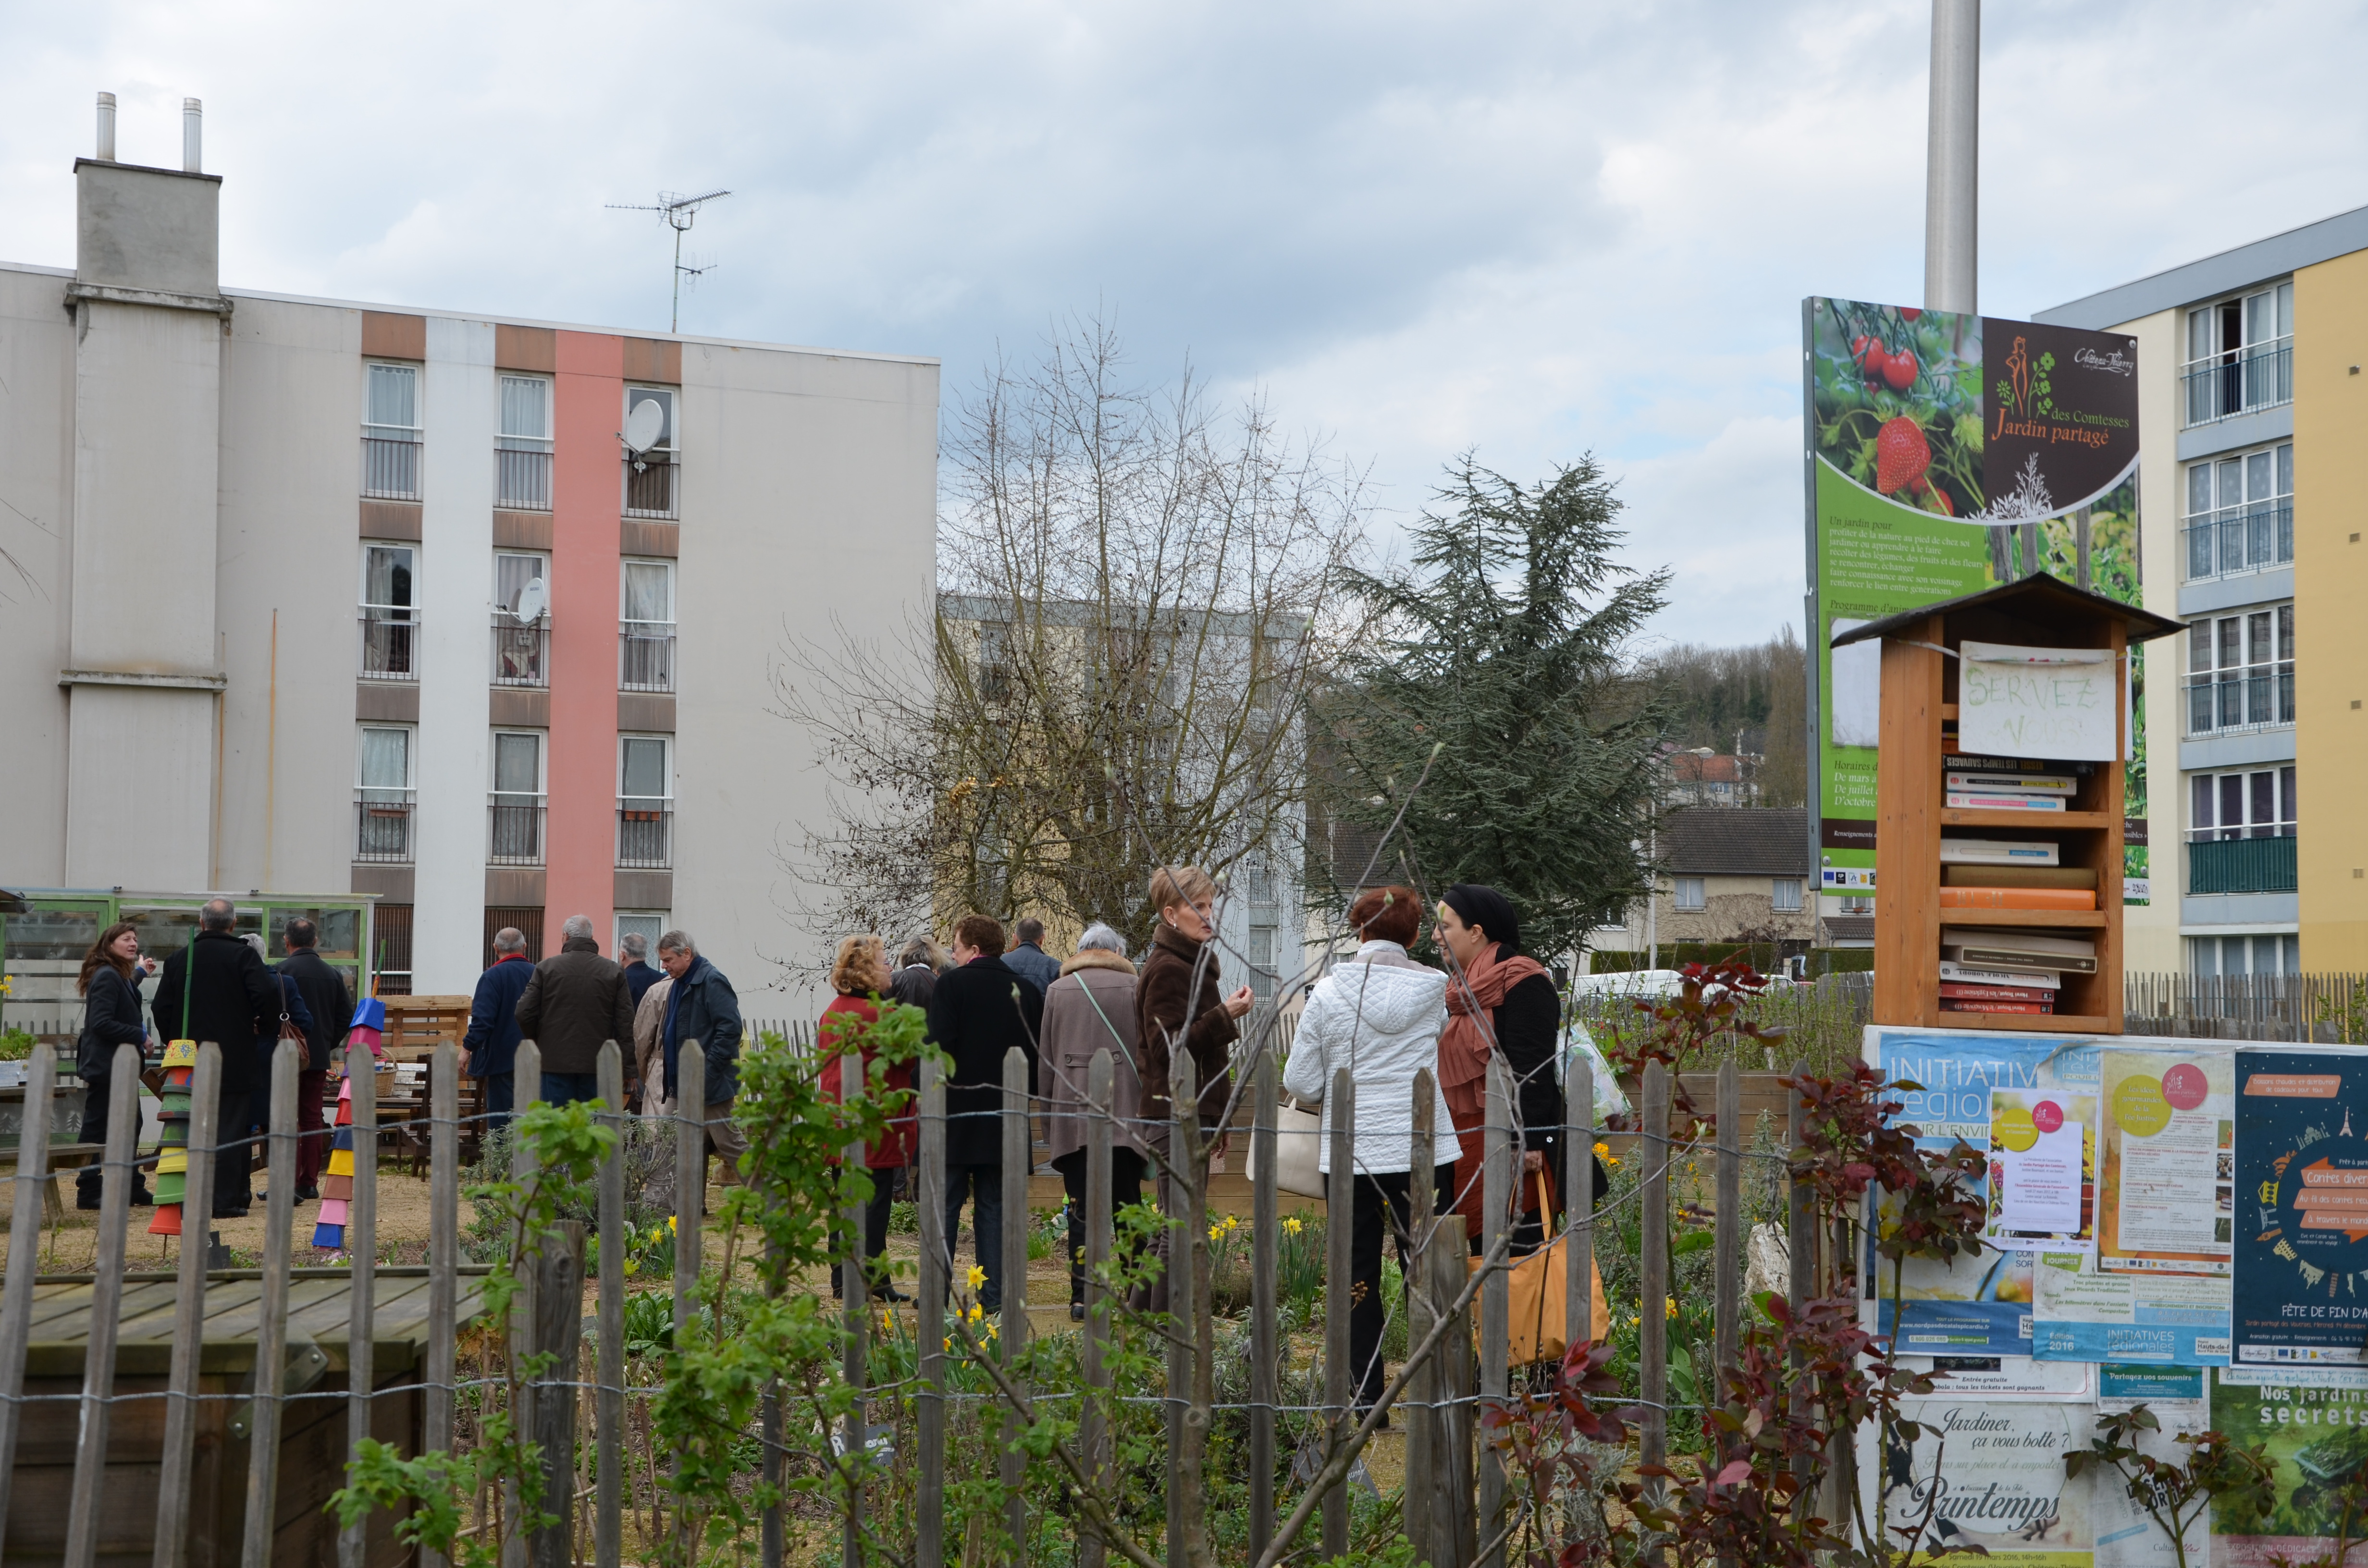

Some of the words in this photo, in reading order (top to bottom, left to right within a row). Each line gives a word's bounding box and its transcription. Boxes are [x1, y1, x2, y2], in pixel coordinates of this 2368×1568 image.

[2052, 407, 2070, 421] des
[2073, 411, 2129, 428] Comtesses
[1992, 408, 2046, 441] Jardin
[2051, 428, 2109, 448] partagé
[1830, 516, 1842, 525] Un
[1843, 518, 1869, 528] jardin
[1873, 522, 1892, 530] pour
[1829, 528, 1857, 537] profiter
[1870, 530, 1876, 539] la
[1878, 533, 1901, 541] nature
[1915, 535, 1930, 545] pied
[1932, 536, 1940, 544] de
[1942, 537, 1958, 546] chez
[1960, 539, 1970, 547] soi
[1829, 538, 1859, 547] jardiner
[1872, 542, 1909, 552] apprendre
[1917, 544, 1923, 552] le
[1925, 545, 1942, 554] faire
[1830, 548, 1858, 557] récolter
[1860, 550, 1872, 558] des
[1874, 551, 1905, 562] légumes,
[1907, 553, 1918, 563] des
[1920, 555, 1939, 564] fruits
[1949, 557, 1961, 566] des
[1963, 558, 1983, 568] fleurs
[1839, 560, 1880, 570] rencontrer,
[1882, 563, 1914, 573] échanger
[1830, 568, 1846, 576] faire
[1849, 570, 1896, 581] connaissance
[1930, 578, 1962, 588] voisinage
[1830, 579, 1864, 588] renforcer
[1875, 581, 1888, 590] lien
[1890, 584, 1908, 592] entre
[1910, 585, 1951, 595] générations
[1830, 600, 1878, 612] Programme
[1966, 667, 2099, 710] SERVEZ
[1834, 760, 1870, 771] Horaires
[1947, 757, 1982, 768] SAUVAGES
[1983, 758, 2006, 769] TEMPS
[2006, 760, 2017, 769] LES
[2021, 760, 2044, 770] KESSEL
[1834, 772, 1846, 781] De
[1834, 784, 1846, 793] De
[1847, 785, 1873, 796] juillet
[2135, 1114, 2158, 1122] Justine
[2307, 1172, 2339, 1183] Contes
[2282, 1303, 2307, 1316] FÊTE
[2311, 1306, 2325, 1317] DE
[2329, 1306, 2349, 1318] FIN
[2049, 1331, 2074, 1340] Édition
[2108, 1329, 2174, 1341] INITIATIVES
[2049, 1341, 2074, 1351] 2016
[2108, 1340, 2175, 1353] régionales
[2109, 1372, 2142, 1382] Partagez
[2260, 1385, 2290, 1401] Nos
[1942, 1408, 2014, 1434] Jardiner,
[1971, 1436, 1987, 1450] ça
[1992, 1437, 2020, 1448] vous
[2023, 1432, 2057, 1448] botte
[2062, 1433, 2070, 1448] ?
[1970, 1458, 1997, 1472] place
[1999, 1458, 2008, 1469] et
[2012, 1460, 2018, 1469] à
[2022, 1458, 2060, 1473] emporter
[1900, 1476, 2061, 1532] Printemps
[2130, 1500, 2136, 1508] DE
[2132, 1507, 2143, 1516] VOS
